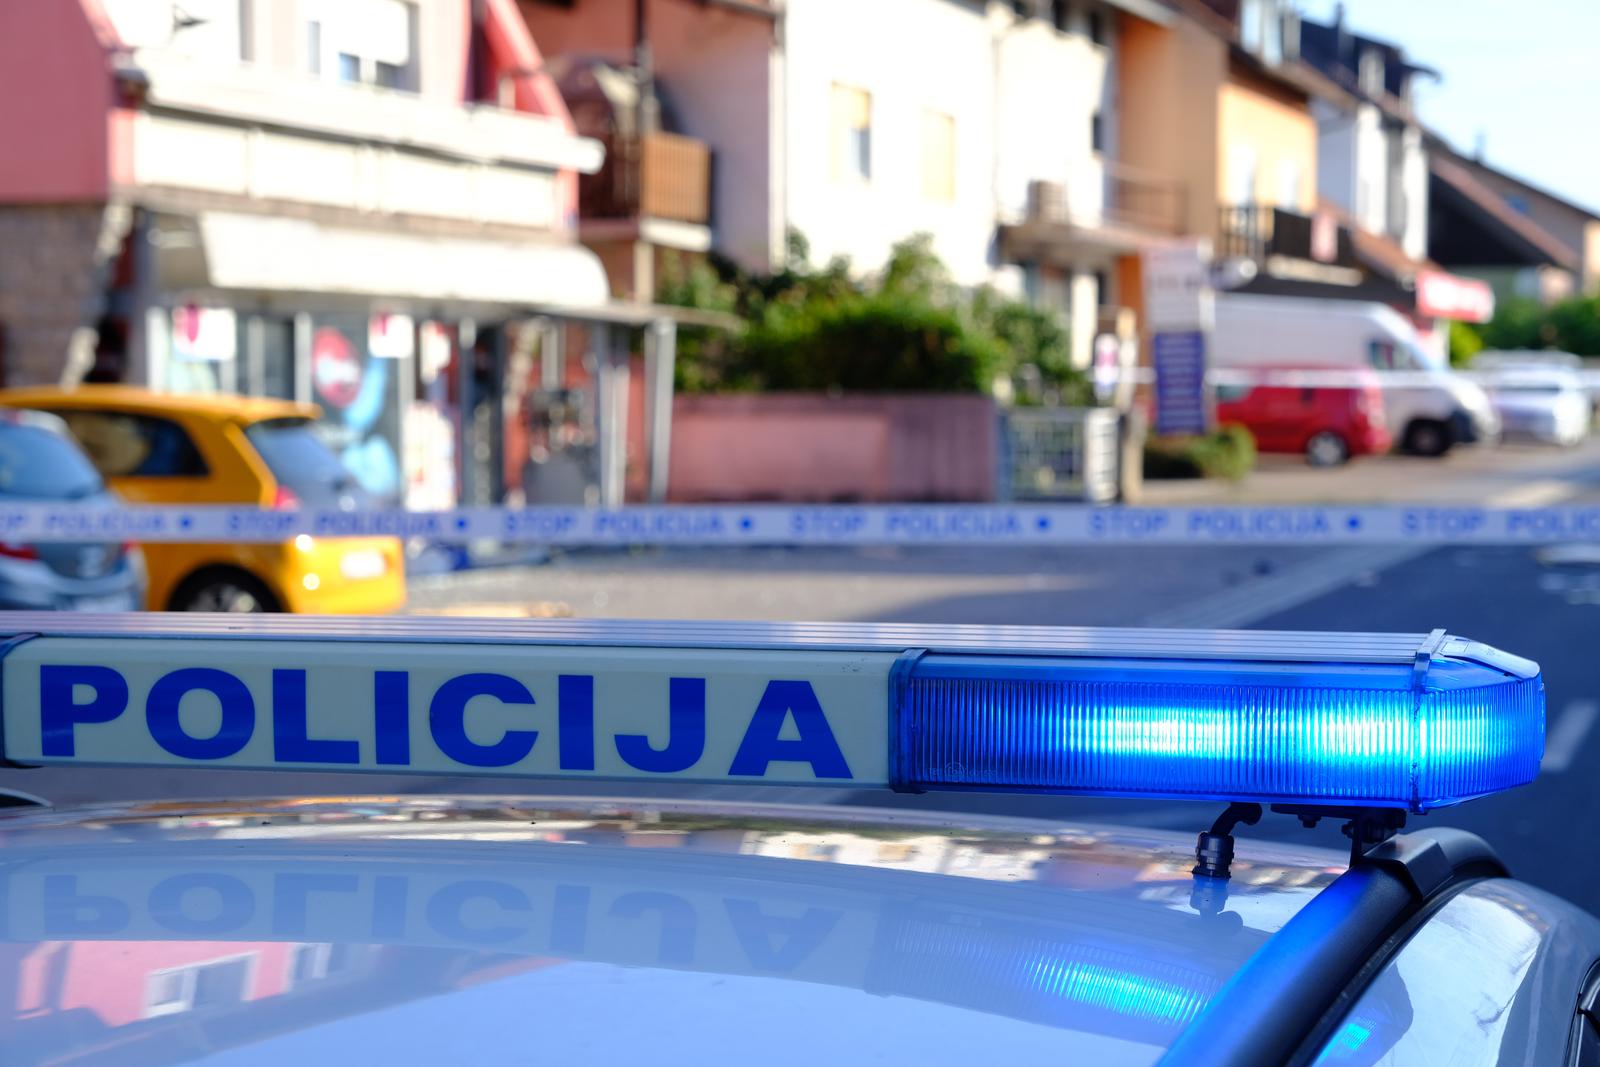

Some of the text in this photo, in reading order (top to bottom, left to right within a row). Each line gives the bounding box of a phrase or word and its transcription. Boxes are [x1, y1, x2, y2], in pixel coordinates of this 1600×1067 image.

[47, 512, 166, 540] POLICIJA
[228, 511, 298, 540] STOP
[315, 511, 441, 540] POLICIJA
[503, 510, 578, 541] STOP
[594, 510, 725, 541] POLICIJA
[790, 510, 867, 542] STOP
[885, 510, 1022, 542] POLICIJA
[1089, 510, 1168, 543] STOP
[1187, 510, 1330, 543] POLICIJA
[1401, 509, 1484, 542] STOP
[40, 665, 853, 779] POLICIJA
